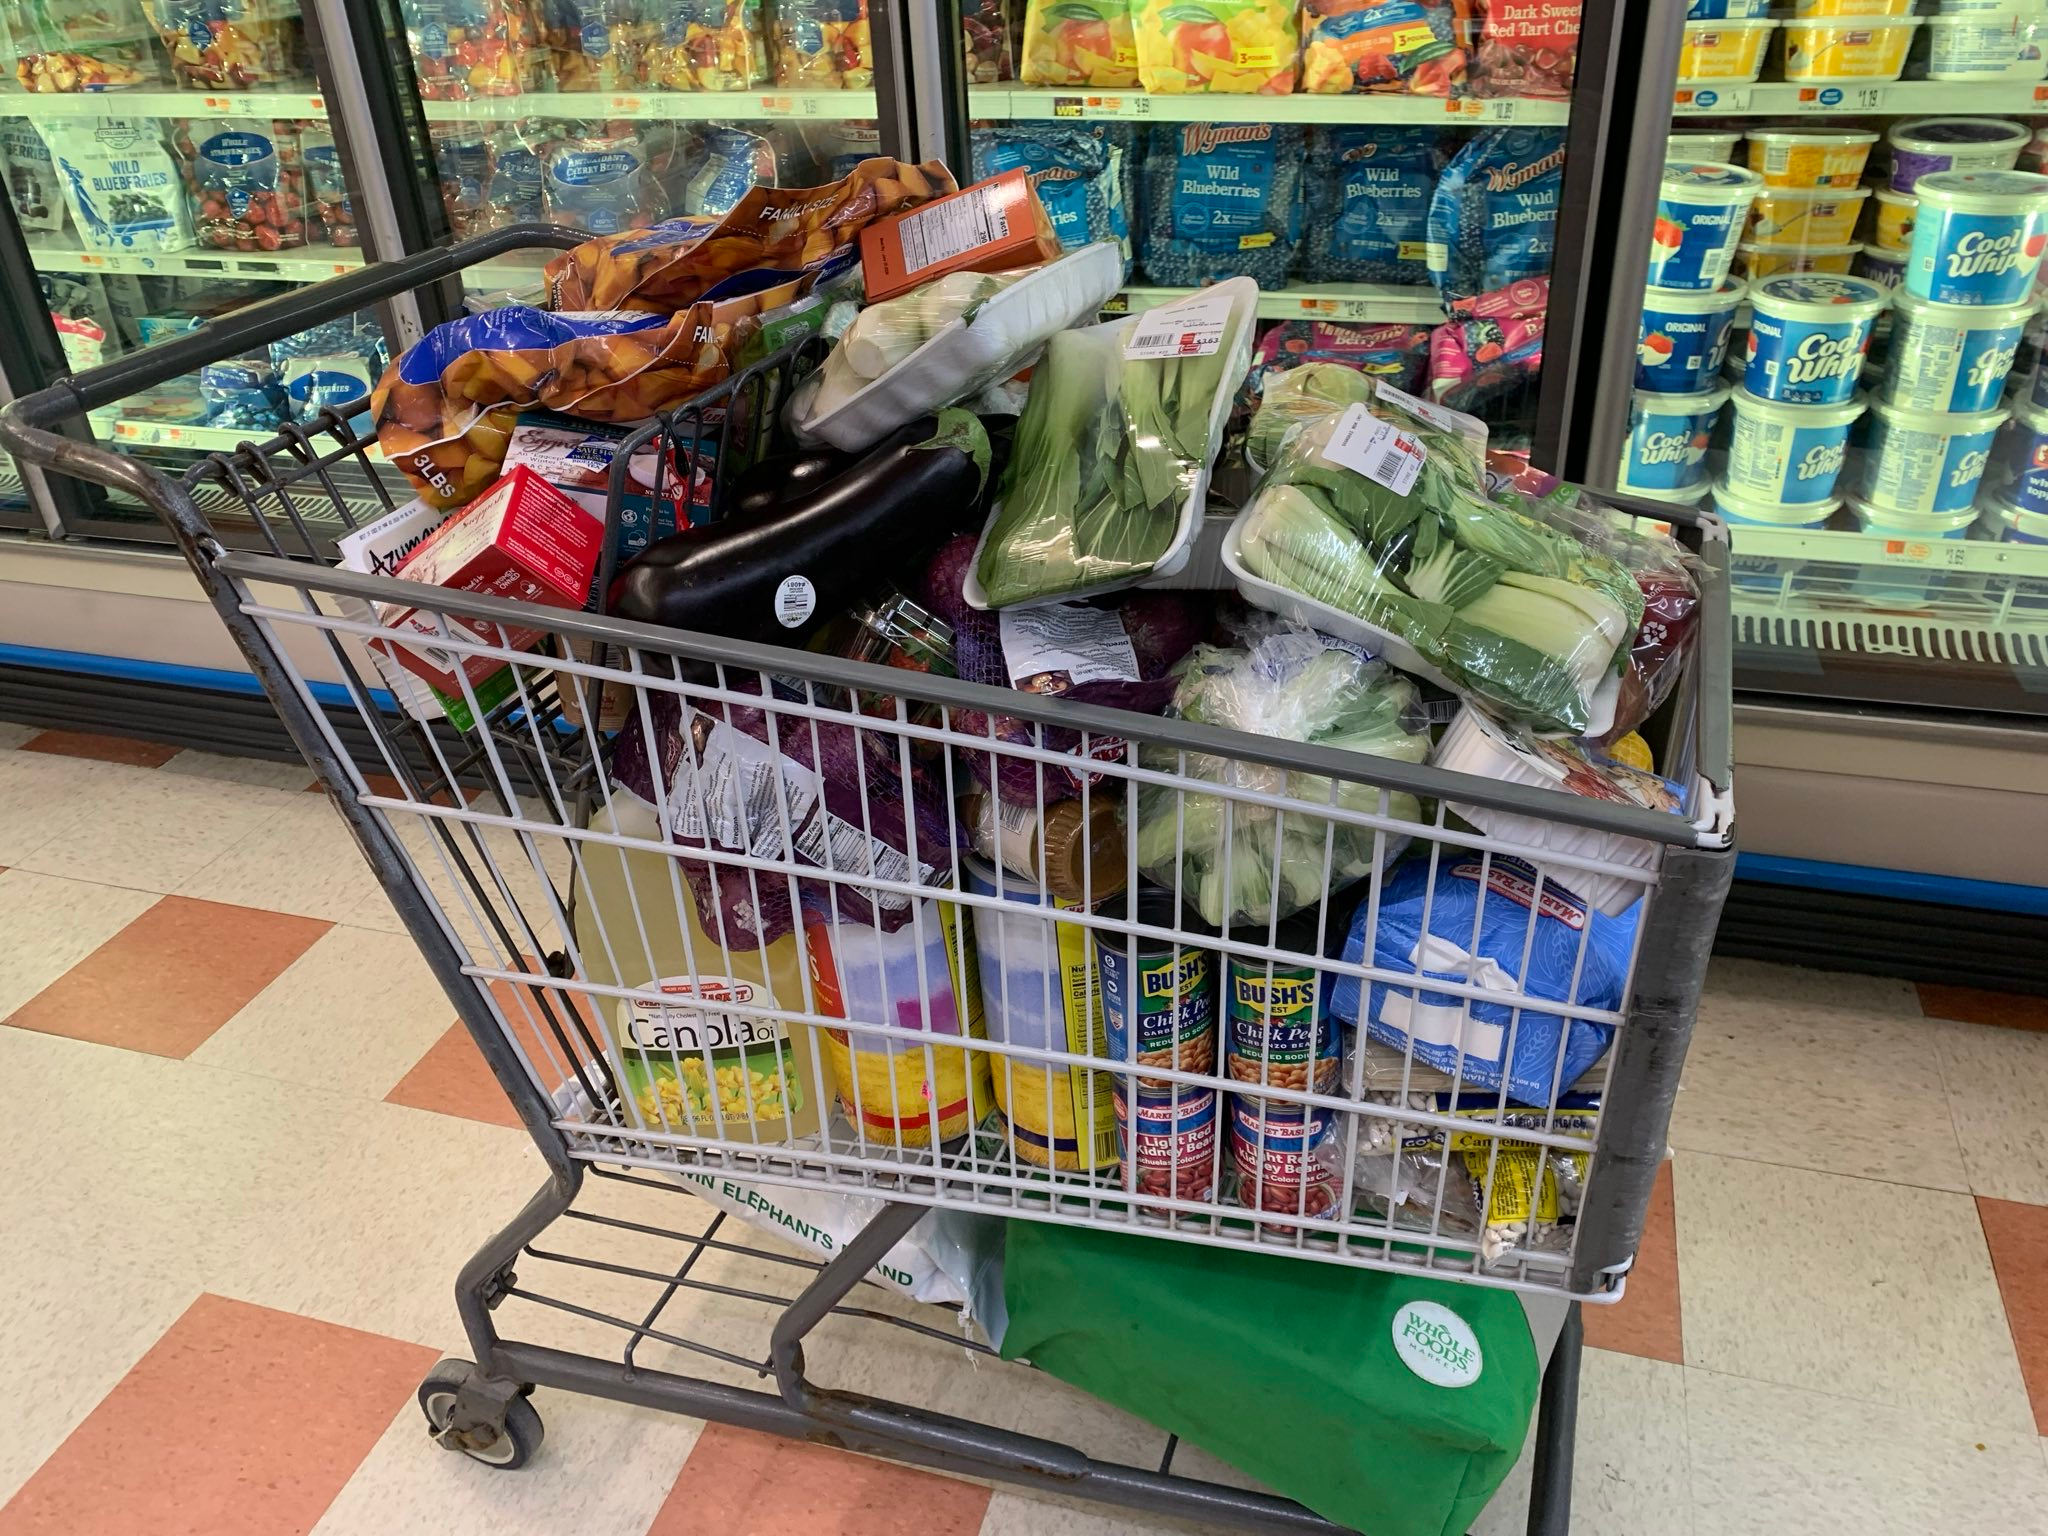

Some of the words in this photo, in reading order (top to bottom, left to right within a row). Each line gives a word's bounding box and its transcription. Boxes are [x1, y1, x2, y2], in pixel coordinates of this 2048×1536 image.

[1503, 4, 1539, 20] Dark
[1541, 3, 1583, 18] Sweet
[1488, 23, 1515, 38] Red
[1518, 20, 1551, 37] Tart
[1553, 19, 1580, 36] Che
[1056, 106, 1081, 116] WIC
[1182, 121, 1272, 155] Wyman's
[109, 160, 140, 176] WILD
[566, 164, 599, 177] CHERRY
[600, 161, 629, 173] BLEND
[1206, 164, 1239, 180] Wild
[1365, 167, 1400, 182] Wild
[92, 172, 168, 191] BLUEBERRIES
[1182, 182, 1261, 198] Blueberries
[1346, 184, 1422, 199] Blueberries
[1516, 190, 1554, 206] Wild
[759, 203, 808, 222] FAMILY
[808, 194, 840, 212] SIZE
[1212, 210, 1230, 224] 2x
[1376, 212, 1393, 225] 2x
[1691, 214, 1731, 226] ORIGINAL
[999, 216, 1010, 237] Facts
[979, 231, 988, 244] 290
[1528, 238, 1547, 253] 2x
[1957, 229, 2022, 257] Cool
[1948, 250, 2018, 278] Whip
[1665, 321, 1706, 333] ORIGINAL
[1798, 325, 1862, 360] Cool
[1977, 340, 2017, 374] Cool
[1786, 351, 1862, 385] Whip
[1646, 430, 1692, 450] Cool
[576, 446, 599, 455] SAVE
[1641, 444, 1690, 466] Whip
[1806, 439, 1846, 466] Cool
[413, 452, 457, 500] 3LBS
[369, 513, 453, 577] Azuma
[499, 572, 521, 590] OWNED
[732, 815, 740, 846] Directions
[1071, 964, 1097, 974] Nutit
[1073, 988, 1100, 998] Calrie
[1179, 981, 1193, 992] EST
[1238, 980, 1315, 1005] BUSH'S
[1271, 1006, 1289, 1014] EST
[627, 1013, 755, 1049] Canola
[756, 1026, 776, 1041] Oi
[1150, 1031, 1191, 1048] REDUED
[1291, 1038, 1323, 1049] BEAS
[1241, 1048, 1283, 1060] REDUED
[1431, 1063, 1486, 1082] HANLING
[1516, 1078, 1529, 1087] not
[1530, 1082, 1540, 1090] Do
[1138, 1108, 1180, 1120] MARKE
[1180, 1095, 1213, 1117] BASKET
[1188, 1125, 1212, 1143] Red
[1405, 1133, 1445, 1147] GOA
[1137, 1144, 1184, 1158] Kidney
[1245, 1143, 1284, 1164] Liht
[1239, 1147, 1282, 1175] Kidey
[1270, 1174, 1315, 1183] Coloraas
[722, 1181, 834, 1251] ELEPHANTS
[1409, 1311, 1476, 1362] WHOLE
[1402, 1323, 1468, 1371] FOODS
[1408, 1343, 1458, 1374] MARKET
